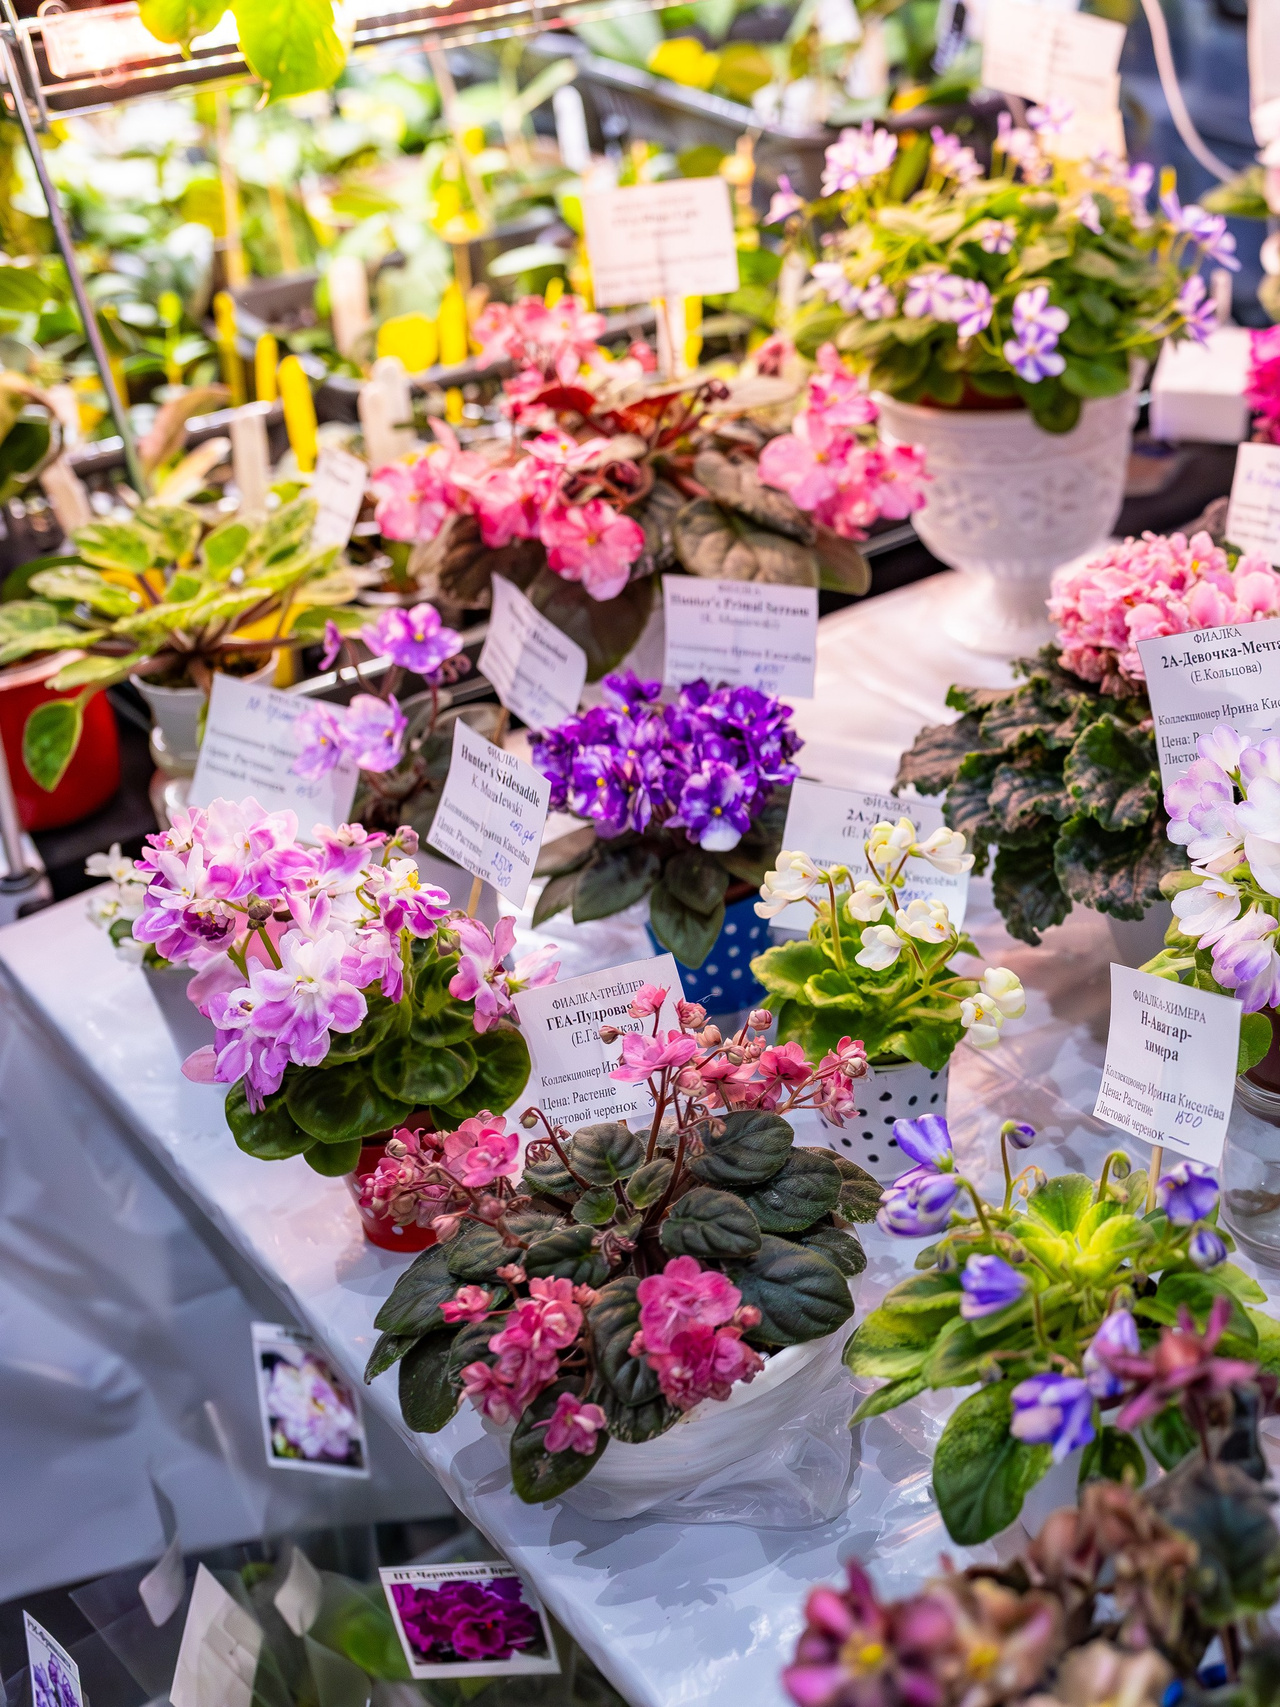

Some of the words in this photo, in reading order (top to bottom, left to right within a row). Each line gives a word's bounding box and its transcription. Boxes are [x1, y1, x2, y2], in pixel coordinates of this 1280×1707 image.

[1193, 627, 1243, 645] ФИАЛКА
[1190, 660, 1263, 685] (Е.Кольцова)
[1158, 709, 1221, 726] Коллекционер
[1221, 701, 1260, 719] Ирина
[1161, 733, 1191, 749] Цена:
[487, 746, 519, 771] ФИАЛКА
[461, 744, 494, 778] Hunter's
[496, 765, 541, 808] Sidesaddle
[863, 795, 912, 815] ФИАЛКА
[551, 979, 645, 1010] ФИАЛКА-ТРЕЙЛЕР
[1132, 989, 1207, 1025] ФИАЛКА-ХИМЕРА
[1144, 1039, 1180, 1062] химера
[541, 1067, 601, 1088] Коллекционер
[542, 1095, 571, 1112] Цена:
[572, 1085, 617, 1105] Растение
[1101, 1081, 1123, 1102] Цена:
[1122, 1091, 1154, 1117] Растение
[1105, 1064, 1147, 1095] Коллекционер
[1147, 1082, 1177, 1104] Ирина
[1177, 1092, 1226, 1122] Киселёва
[593, 1101, 638, 1119] черенок
[1096, 1100, 1131, 1127] Листовой
[1131, 1119, 1165, 1142] черенок
